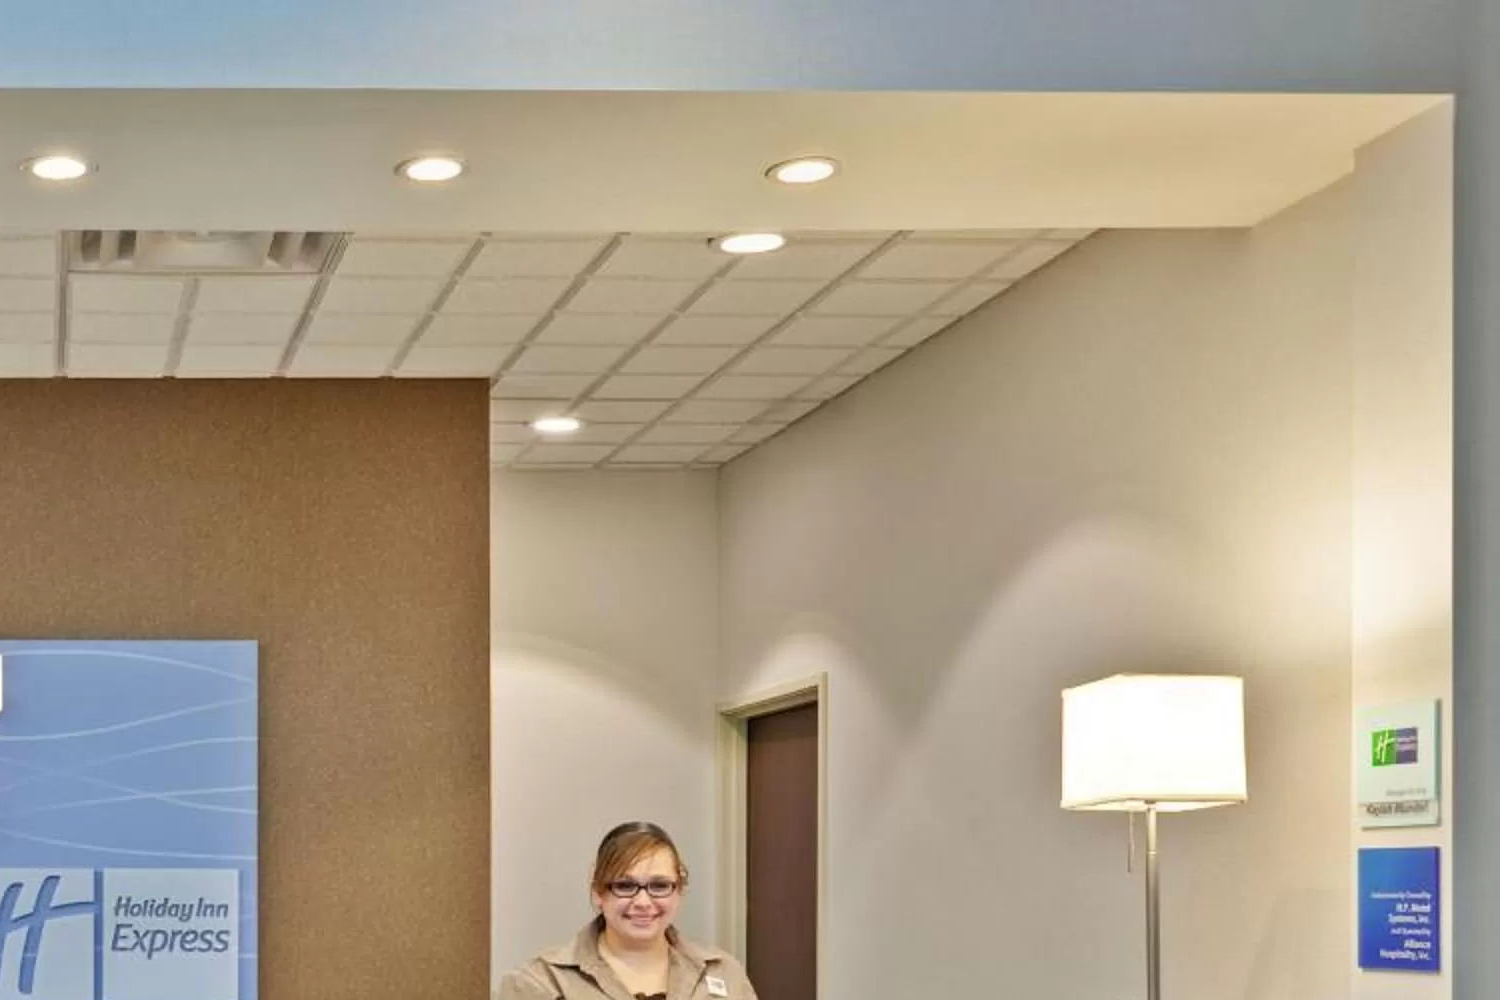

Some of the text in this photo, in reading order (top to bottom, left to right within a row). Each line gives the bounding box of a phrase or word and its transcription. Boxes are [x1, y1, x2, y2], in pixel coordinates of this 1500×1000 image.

[113, 895, 229, 921] Holiday Inn
[111, 923, 231, 960] Express
